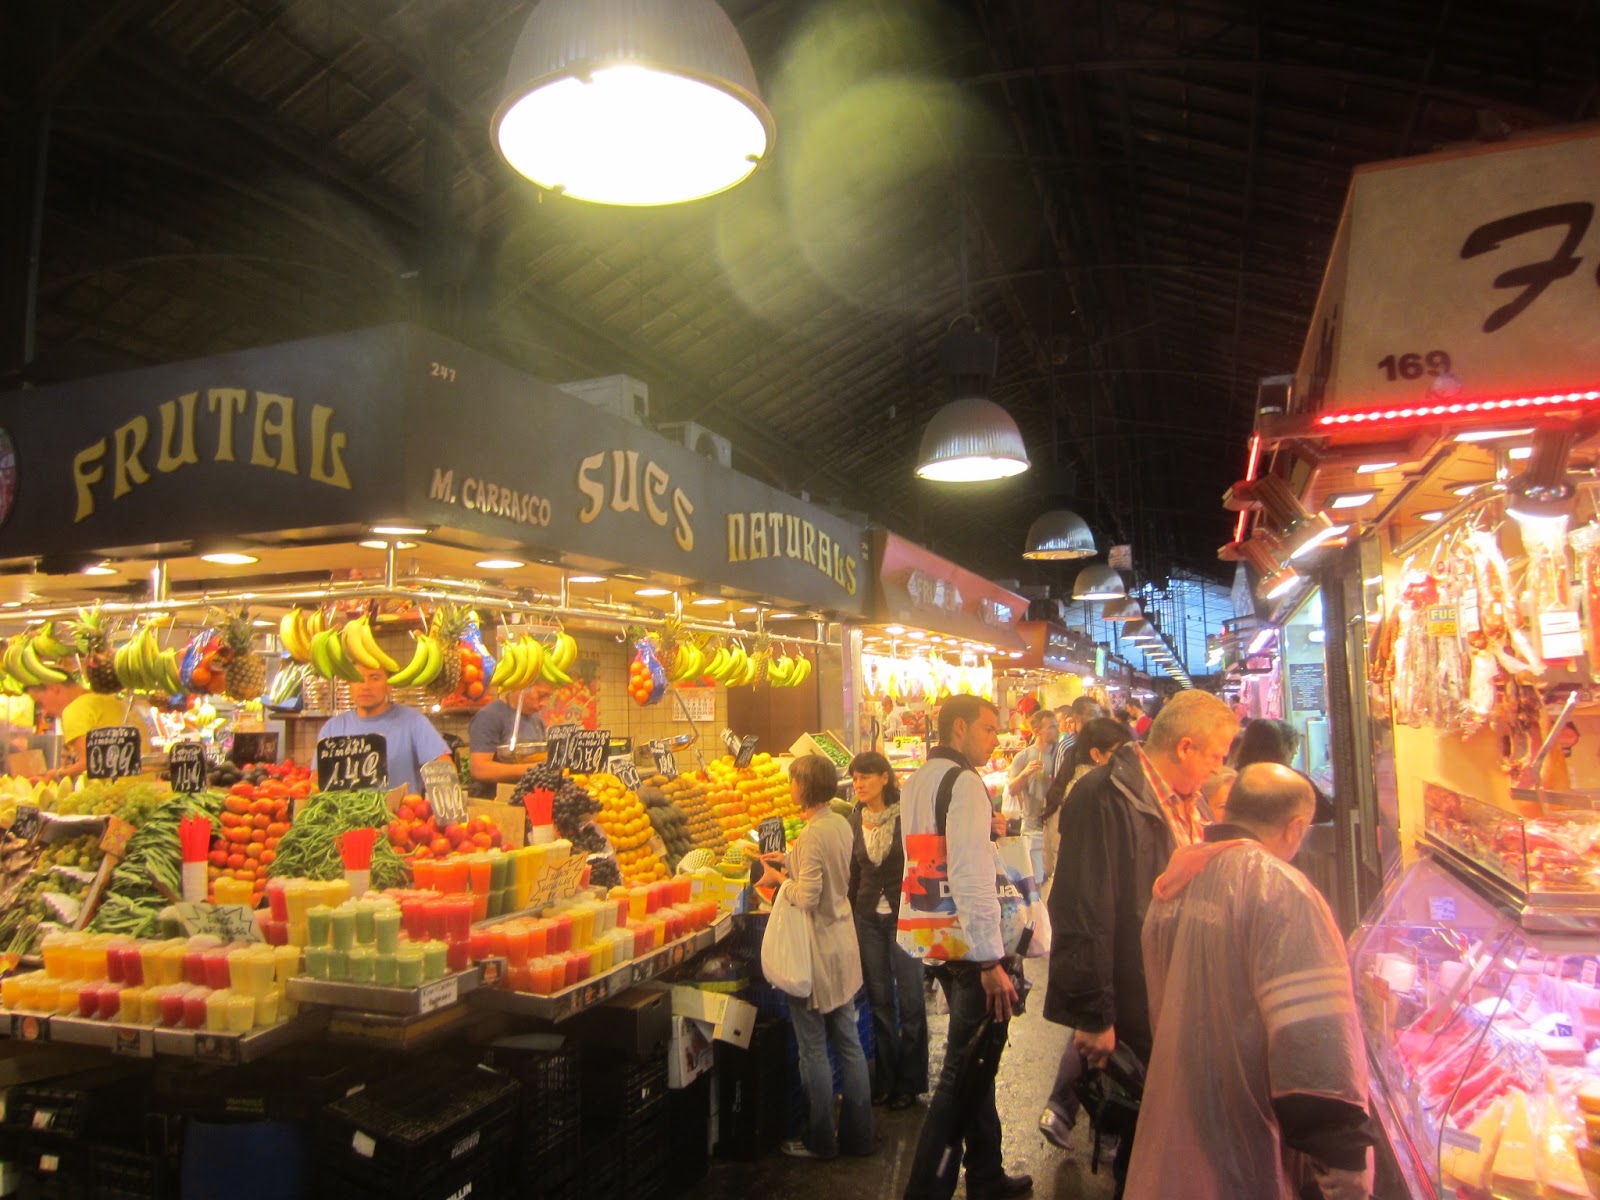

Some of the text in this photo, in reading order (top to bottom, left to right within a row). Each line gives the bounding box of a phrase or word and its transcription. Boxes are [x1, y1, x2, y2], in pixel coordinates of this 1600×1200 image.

[431, 362, 457, 383] 247
[1377, 350, 1452, 382] 169
[73, 387, 352, 523] FRUTAL
[430, 468, 551, 527] M. CARRASCO
[577, 450, 857, 596] SUCS NATURALS
